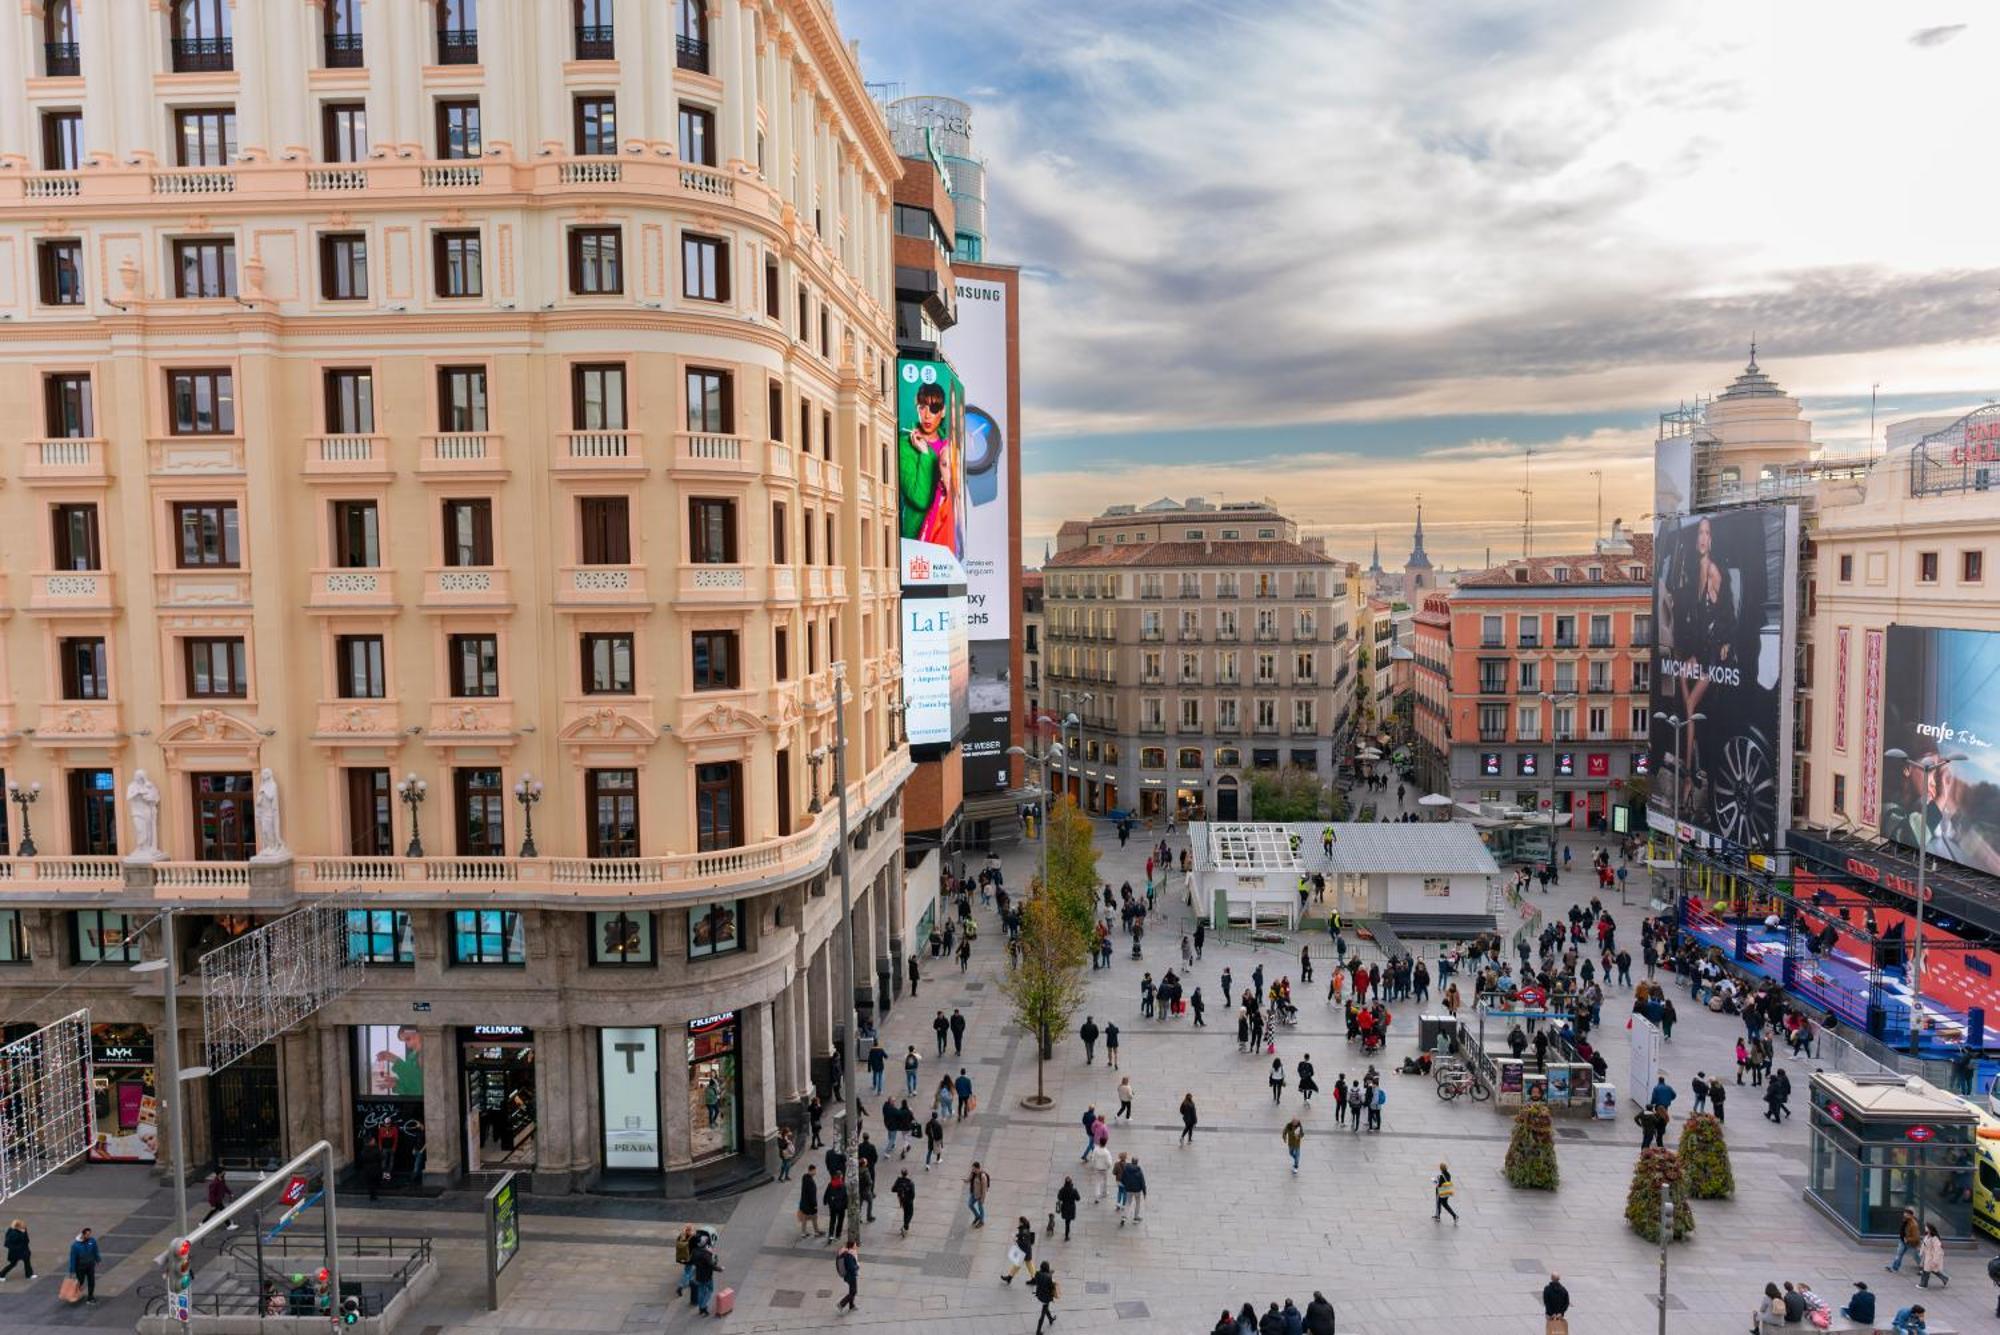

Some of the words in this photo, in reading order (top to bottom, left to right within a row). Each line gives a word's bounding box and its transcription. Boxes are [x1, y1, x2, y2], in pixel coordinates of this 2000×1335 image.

[912, 612, 934, 632] La
[1661, 658, 1707, 681] MICHAEL
[1708, 665, 1741, 686] KORS
[1916, 721, 1955, 744] renfe
[1886, 873, 1933, 901] CALLO
[105, 1047, 133, 1059] NYX
[614, 1143, 654, 1153] PRADA
